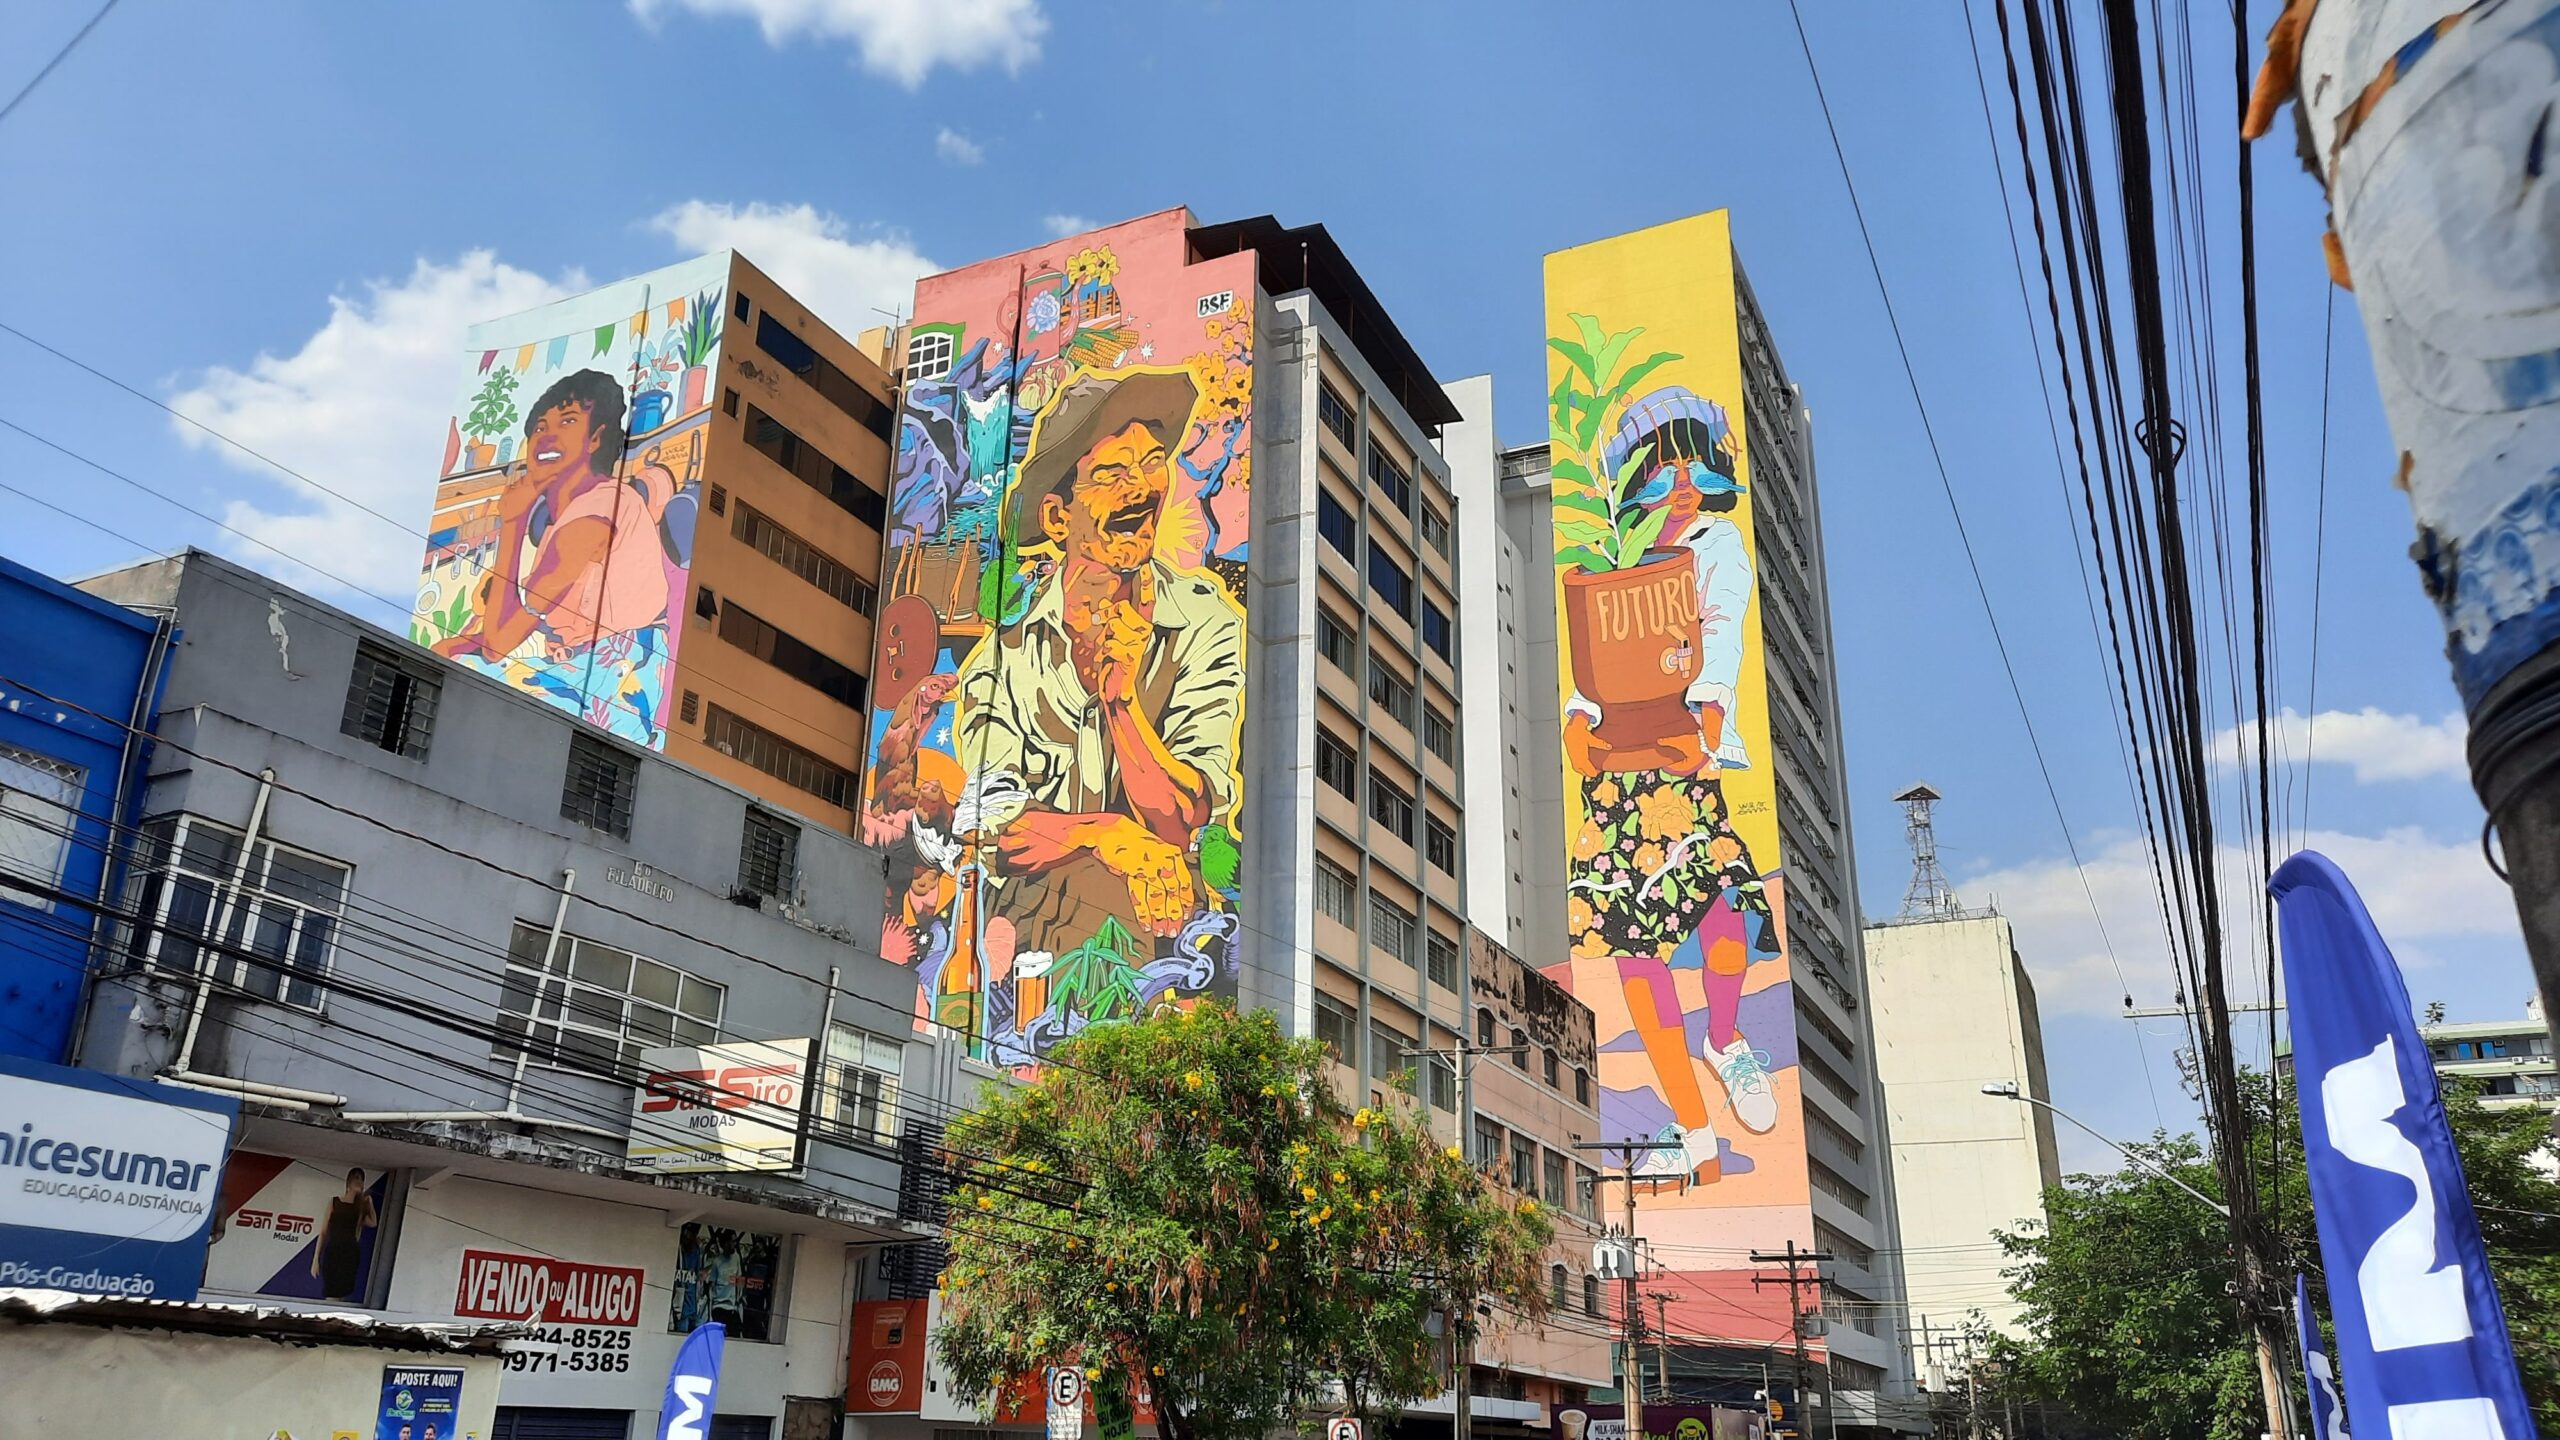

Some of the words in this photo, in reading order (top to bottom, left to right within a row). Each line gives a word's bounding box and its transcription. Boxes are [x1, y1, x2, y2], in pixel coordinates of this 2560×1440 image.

[1596, 570, 1699, 642] FUTURO
[641, 1069, 716, 1113] San
[715, 1063, 797, 1109] Siro
[689, 1115, 737, 1129] MODAS
[24, 1178, 112, 1204] EDUCAÇÃO
[113, 1191, 125, 1205] A
[128, 1193, 203, 1215] DISTÂNCIA
[235, 1209, 273, 1230] San
[275, 1214, 314, 1235] Siro
[273, 1232, 299, 1243] Modas
[1, 1261, 154, 1296] Pós-Graduação
[467, 1258, 550, 1315] VENDO
[560, 1271, 637, 1322] ALUGO
[393, 1372, 430, 1386] APOSTE
[431, 1373, 458, 1388] AQUI!
[870, 1378, 899, 1393] BMG
[1060, 1374, 1072, 1398] E
[1594, 1423, 1626, 1435] MILK-SHAK
